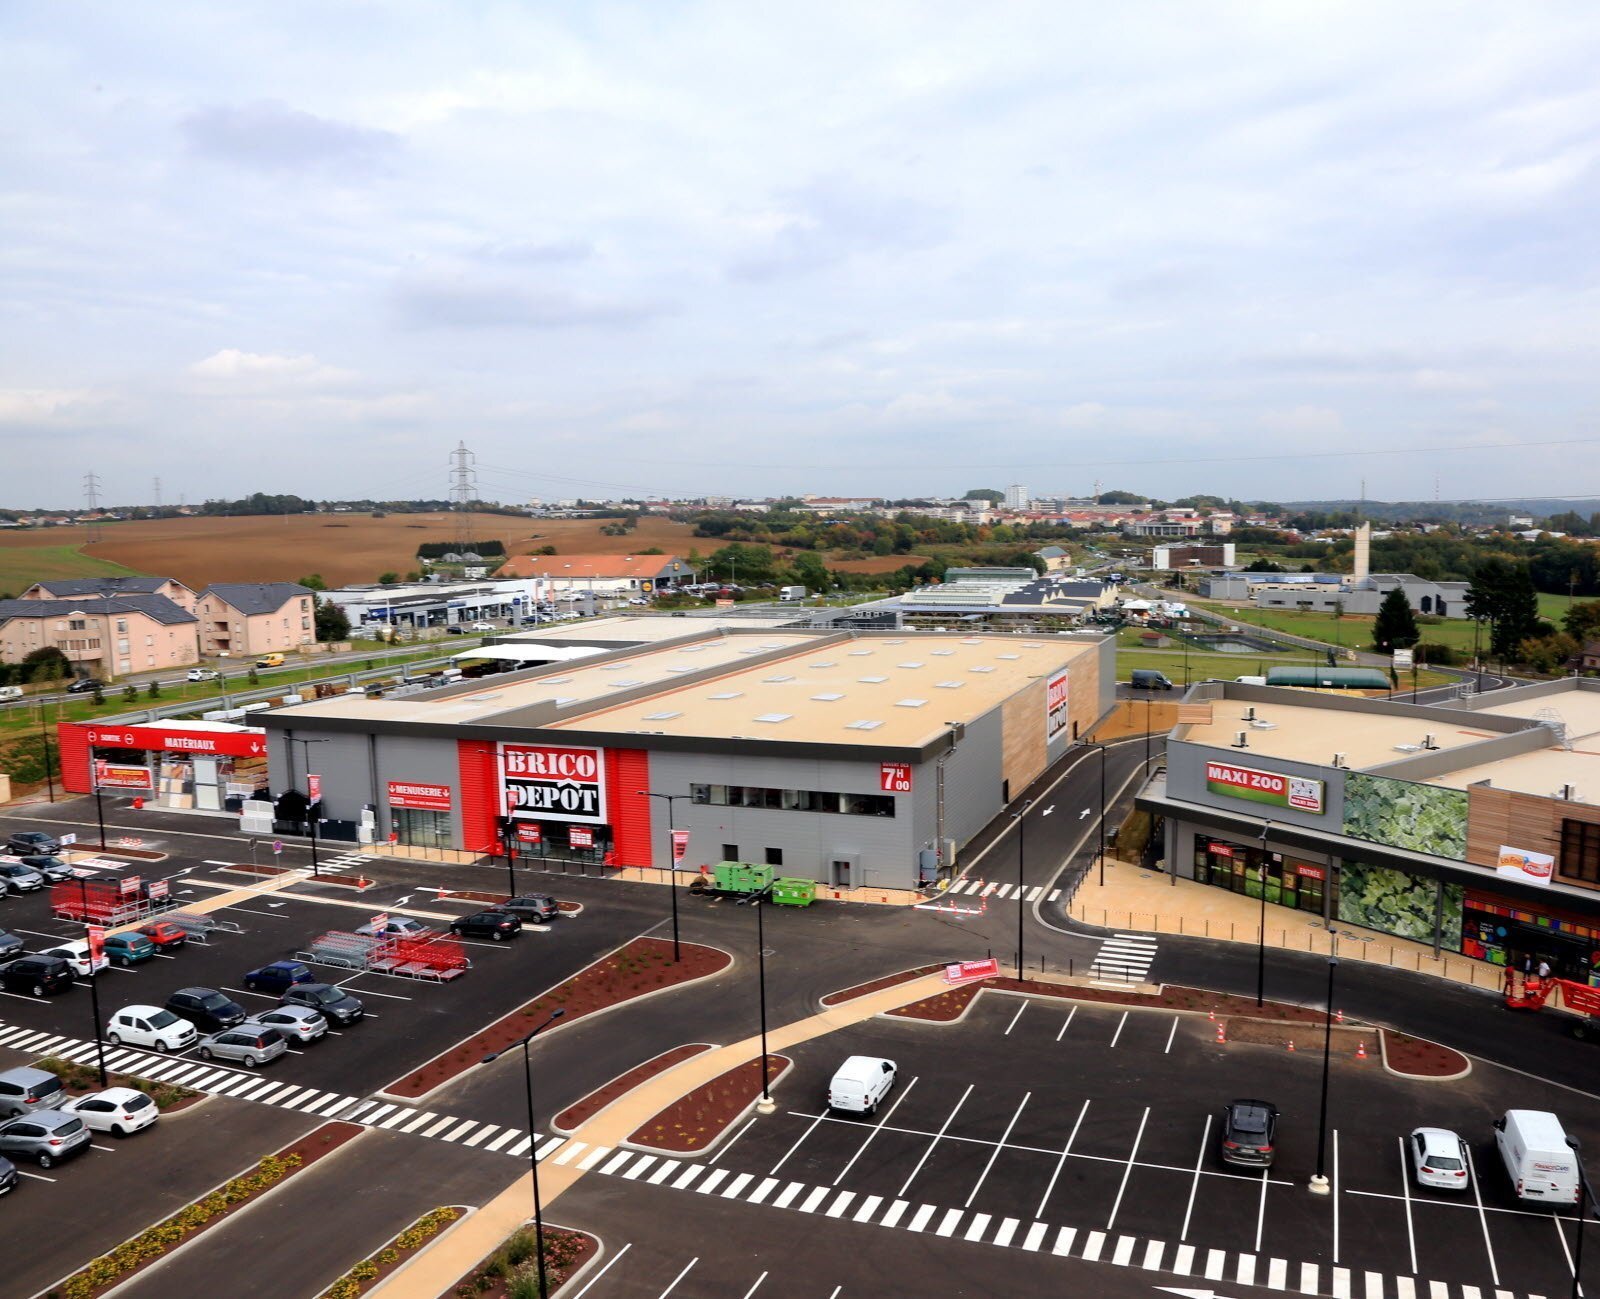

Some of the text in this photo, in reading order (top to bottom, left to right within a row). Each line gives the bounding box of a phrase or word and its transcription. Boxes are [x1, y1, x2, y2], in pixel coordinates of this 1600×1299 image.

[164, 736, 216, 751] MATÉRIAUX
[506, 750, 596, 778] BRICO
[882, 767, 896, 790] 7
[895, 780, 910, 791] 00
[1208, 766, 1283, 791] MAXI ZOO
[395, 785, 443, 797] MENUISERIE
